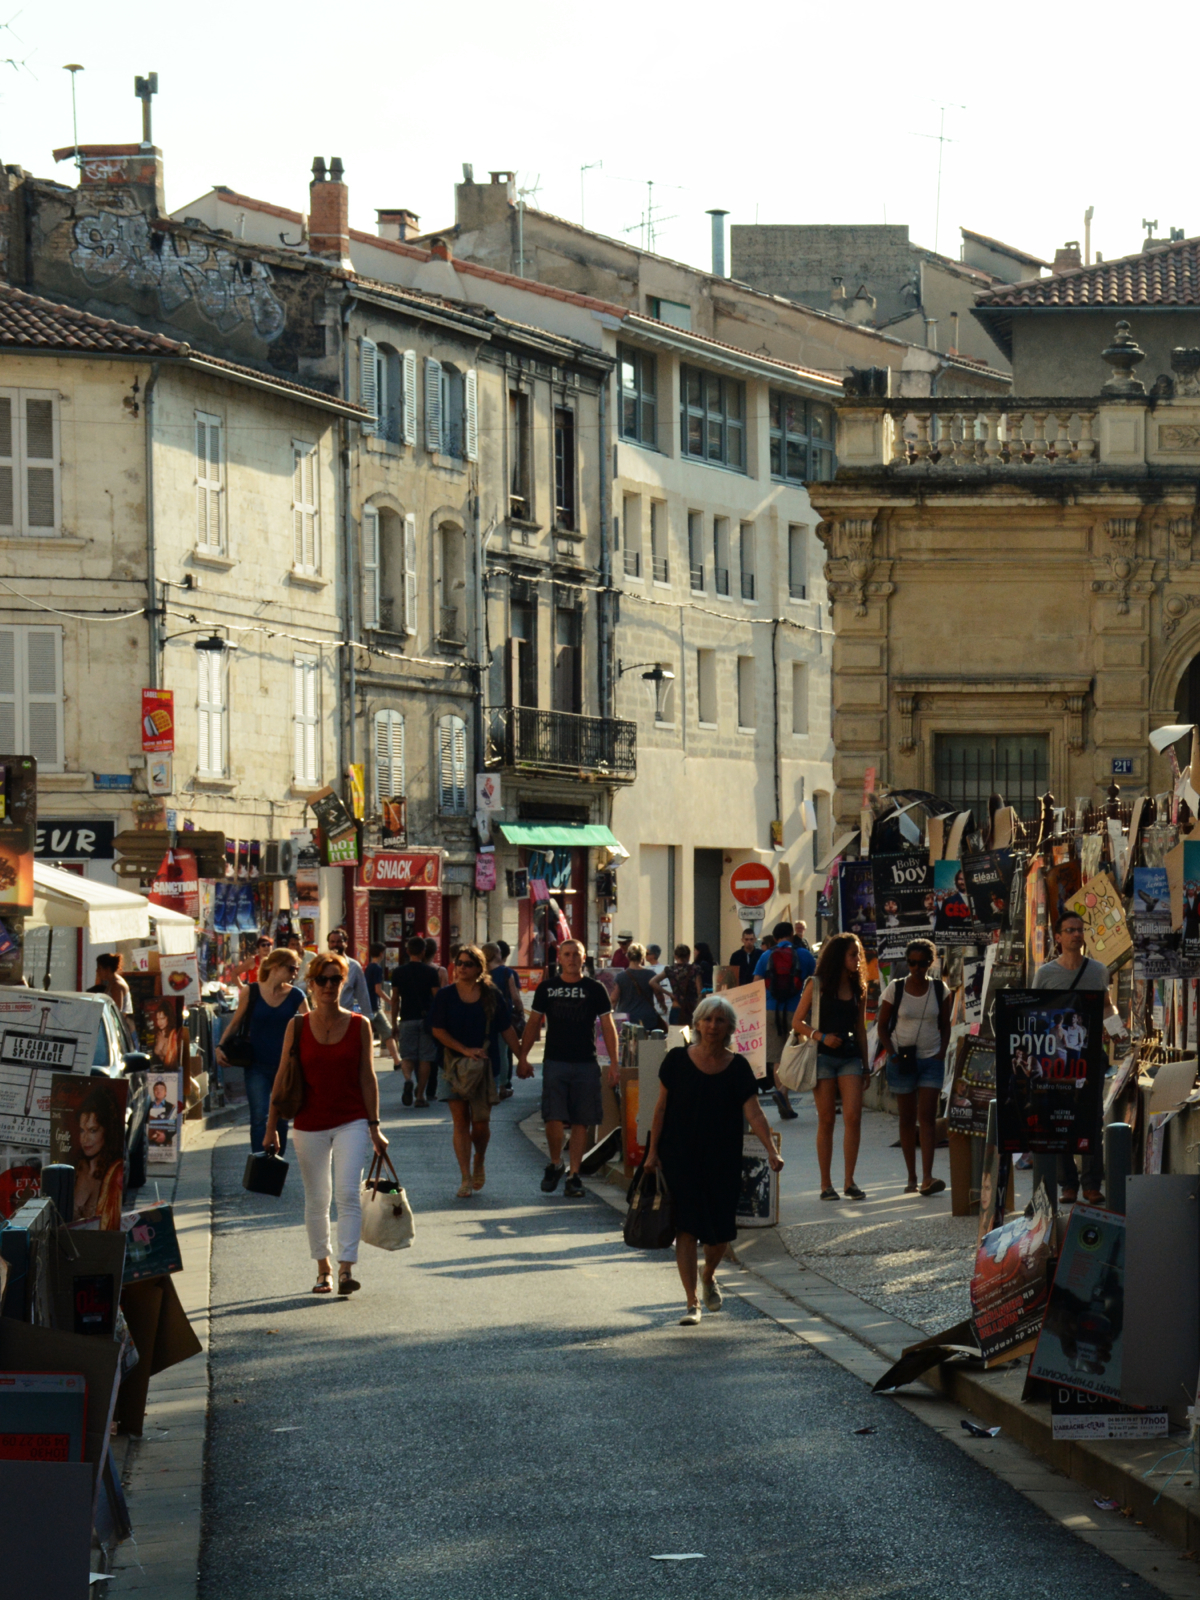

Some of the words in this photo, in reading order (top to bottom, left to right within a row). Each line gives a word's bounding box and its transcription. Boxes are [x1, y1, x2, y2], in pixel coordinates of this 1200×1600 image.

[384, 835, 406, 846] SNACK
[376, 860, 412, 879] SNACK
[891, 864, 927, 885] boy
[547, 987, 586, 999] DIESEL
[14, 1038, 24, 1048] LE
[26, 1040, 49, 1051] CLOU
[52, 1043, 65, 1053] DU
[1010, 1034, 1056, 1056] POYO
[12, 1047, 63, 1063] SPECTACLE
[1041, 1058, 1087, 1079] ROJO
[1014, 1331, 1025, 1340] du
[982, 1337, 1014, 1358] rempart
[1036, 1366, 1094, 1389] D'HIPPOCRATE
[1140, 1416, 1166, 1425] 17h00
[18, 1436, 33, 1447] 27
[55, 1436, 69, 1447] 04
